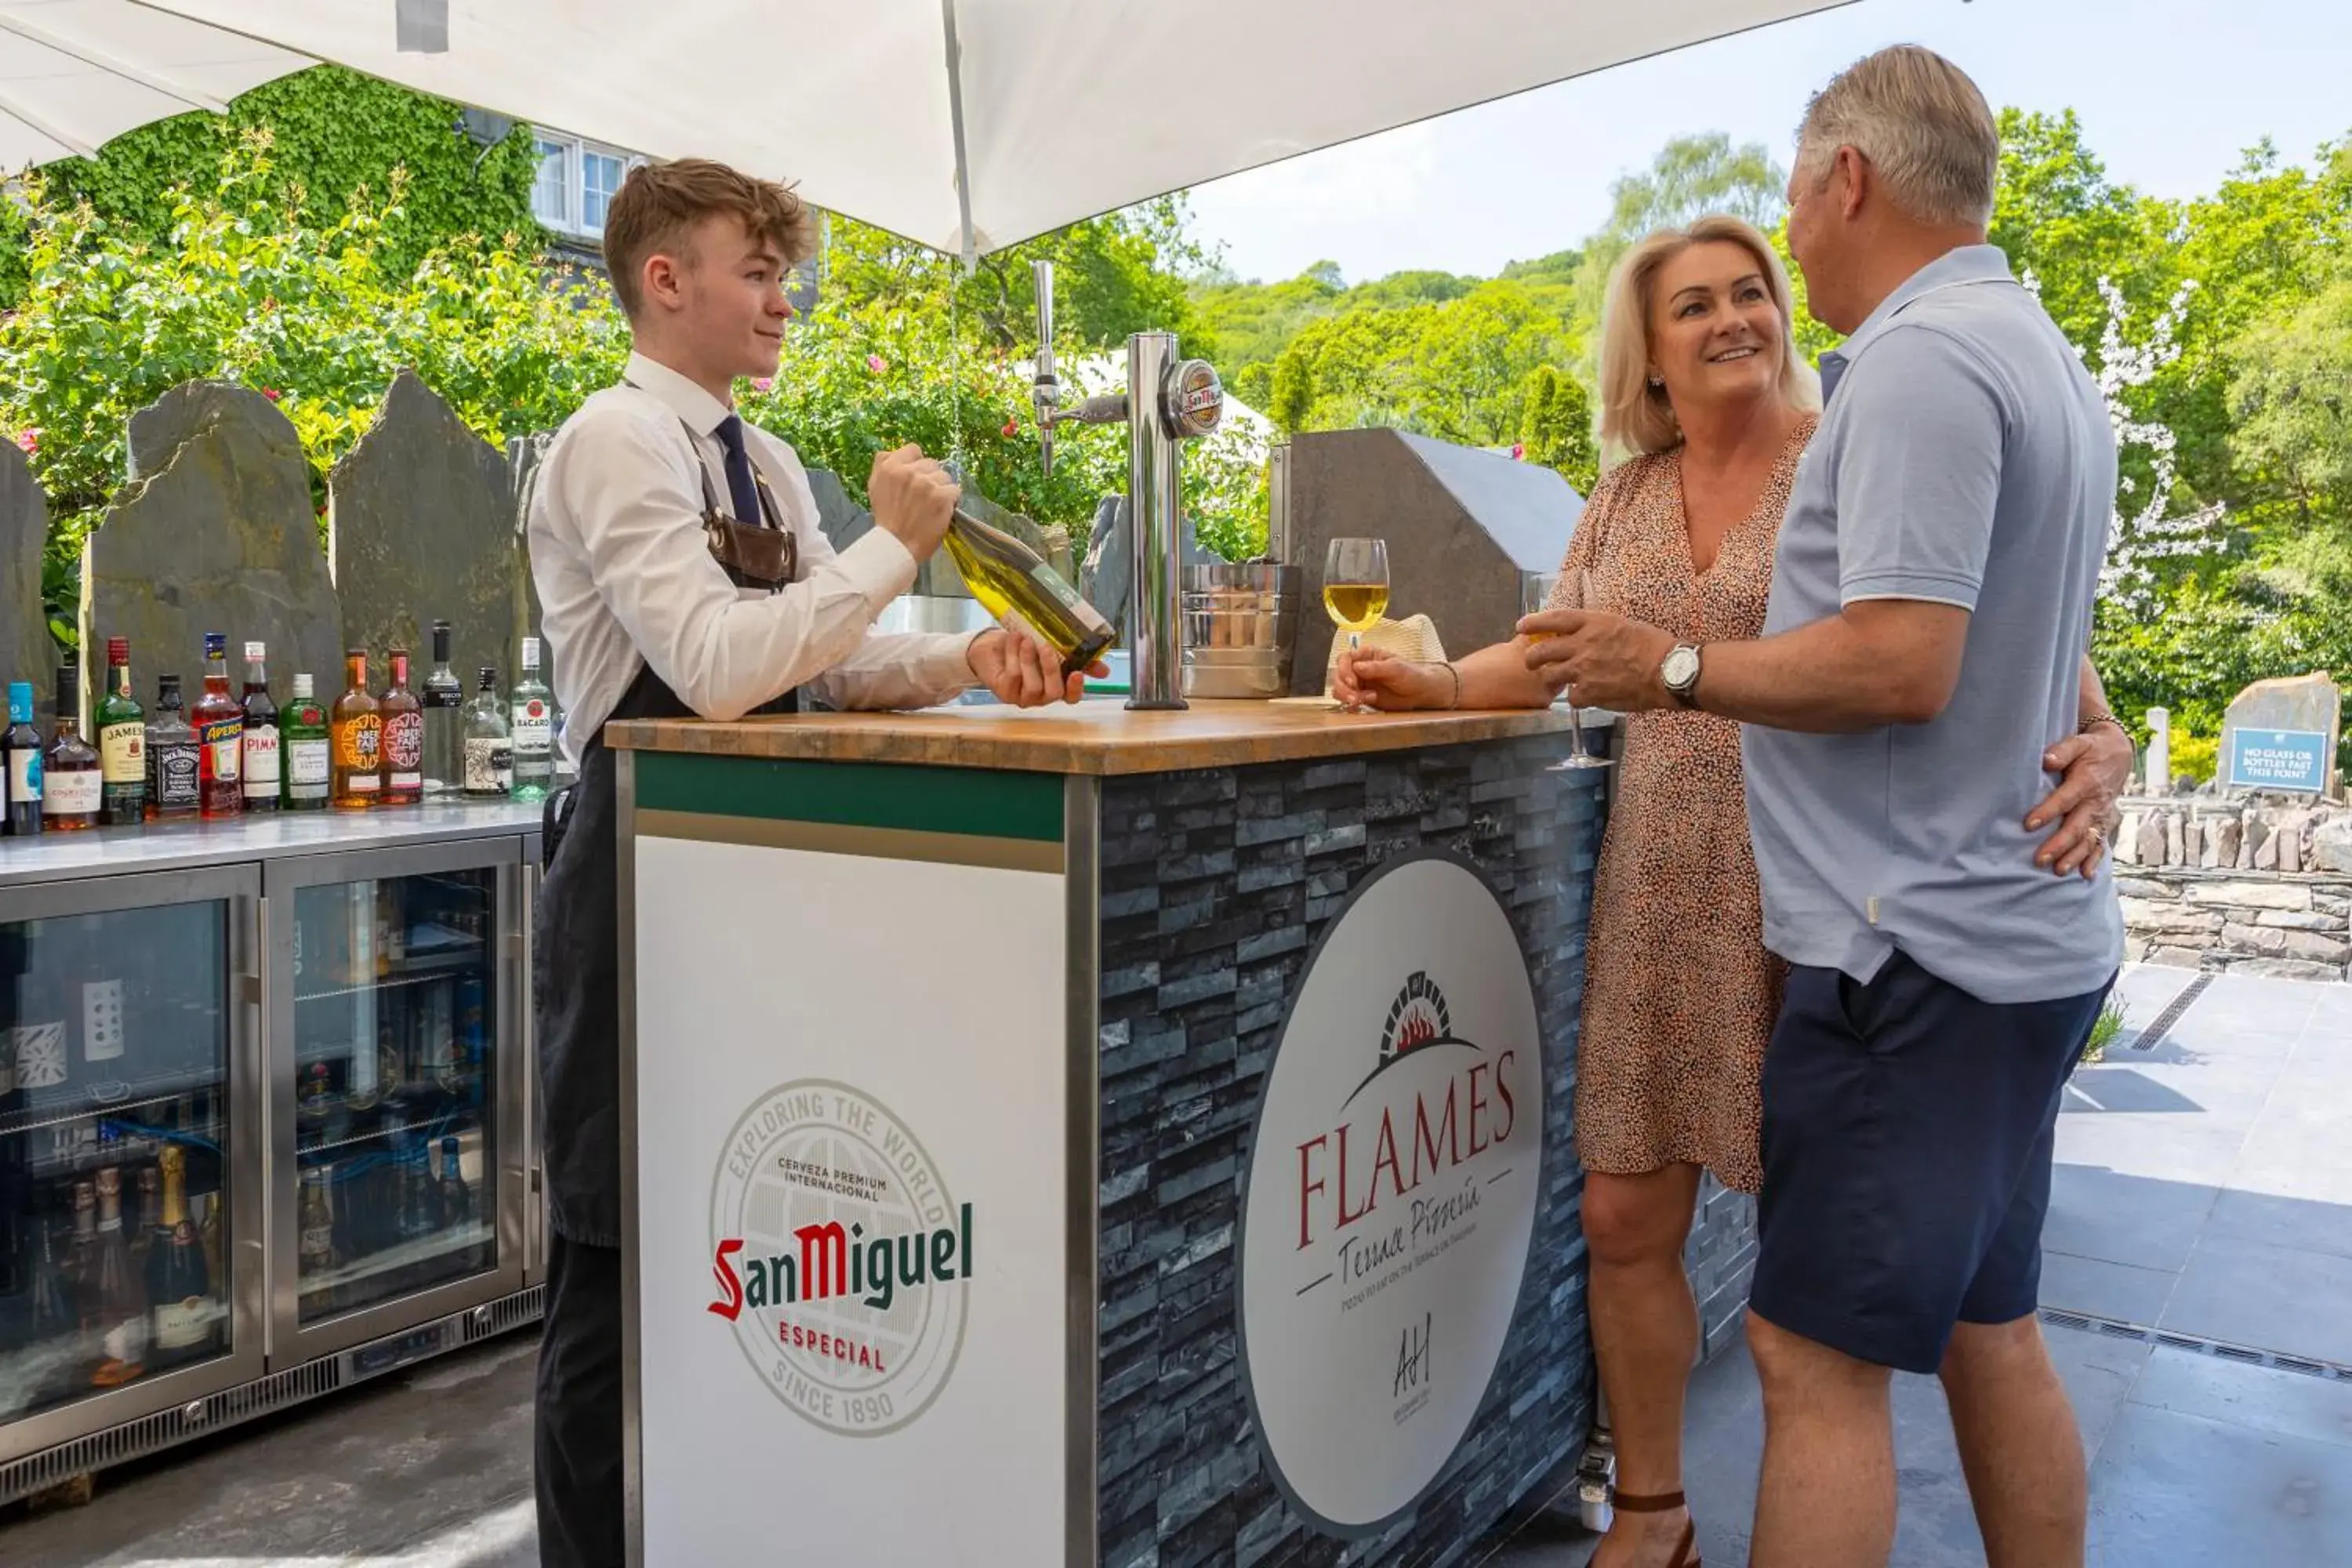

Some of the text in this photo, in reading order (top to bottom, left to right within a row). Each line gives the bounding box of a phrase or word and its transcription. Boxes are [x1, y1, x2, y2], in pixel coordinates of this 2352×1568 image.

[2243, 757, 2312, 770] BOTTLES PAST
[2244, 748, 2312, 760] NO GLASS OR
[2246, 767, 2308, 779] THIS POINT
[728, 1092, 946, 1225] EXPLORING THE WORLD
[1296, 1050, 1515, 1250] FLAMES
[778, 1157, 887, 1192] CERVEZA PREMIUM
[784, 1172, 879, 1203] INTERNACIONAL
[779, 1320, 886, 1374] ESPECIAL
[771, 1359, 895, 1424] SINCE 1890
